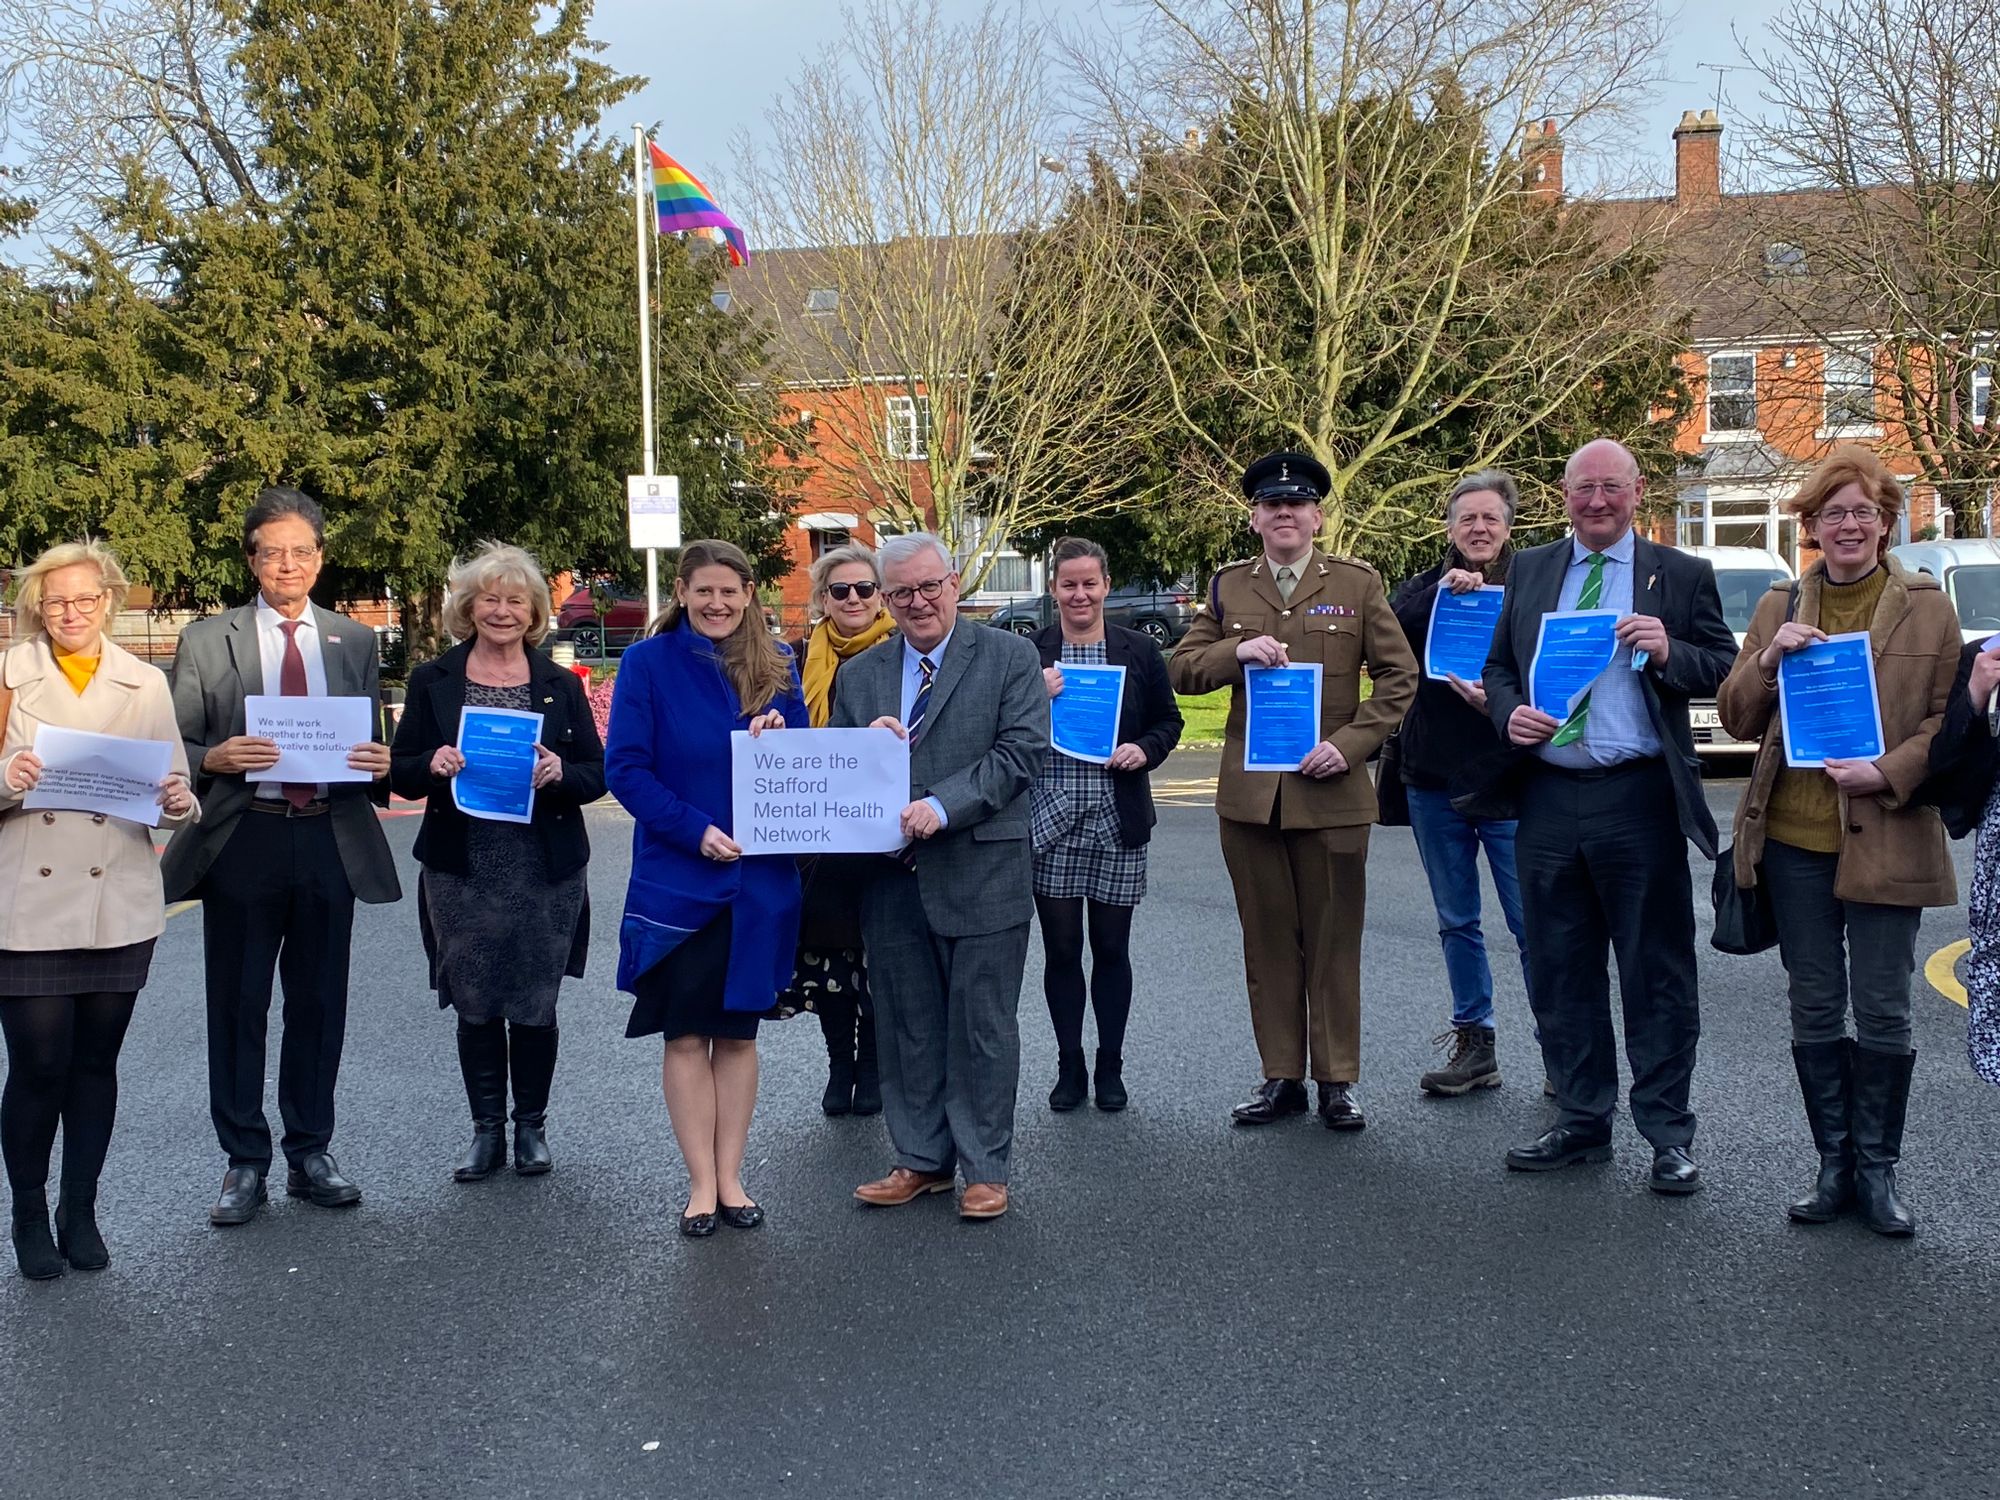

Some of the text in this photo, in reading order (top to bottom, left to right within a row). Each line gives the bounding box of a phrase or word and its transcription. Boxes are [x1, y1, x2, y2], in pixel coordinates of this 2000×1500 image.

[258, 718, 322, 727] We will work
[258, 730, 336, 739] together to find
[754, 753, 858, 770] We are the
[64, 775, 91, 783] people
[92, 779, 125, 789] entering
[754, 777, 828, 794] Stafford
[95, 786, 141, 797] progressive
[754, 801, 884, 819] Mental Health
[754, 826, 831, 843] Network
